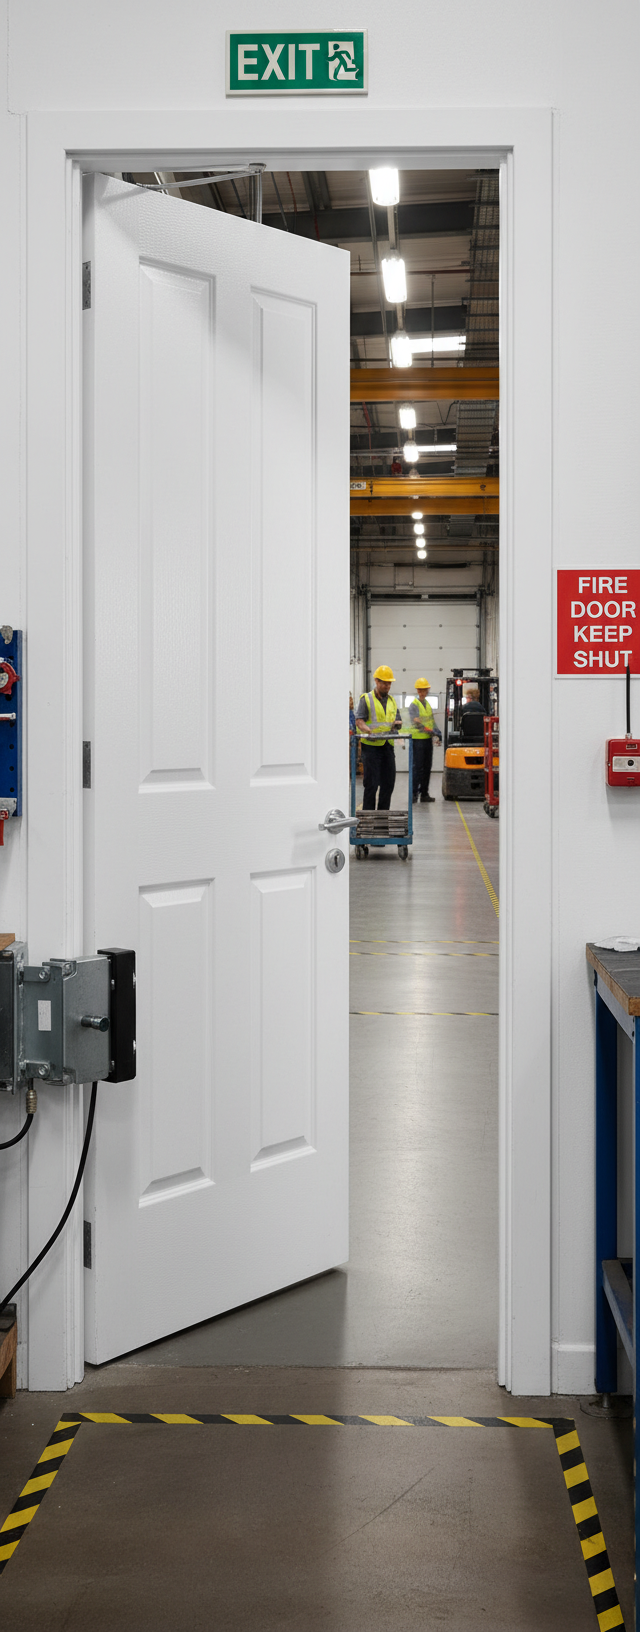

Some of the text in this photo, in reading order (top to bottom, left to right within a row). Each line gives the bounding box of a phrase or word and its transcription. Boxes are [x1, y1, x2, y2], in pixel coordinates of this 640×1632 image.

[238, 43, 320, 80] EXIT
[578, 576, 628, 594] FIRE
[570, 600, 636, 618] DOOR
[573, 625, 633, 642] KEEP
[573, 650, 633, 667] SHUT
